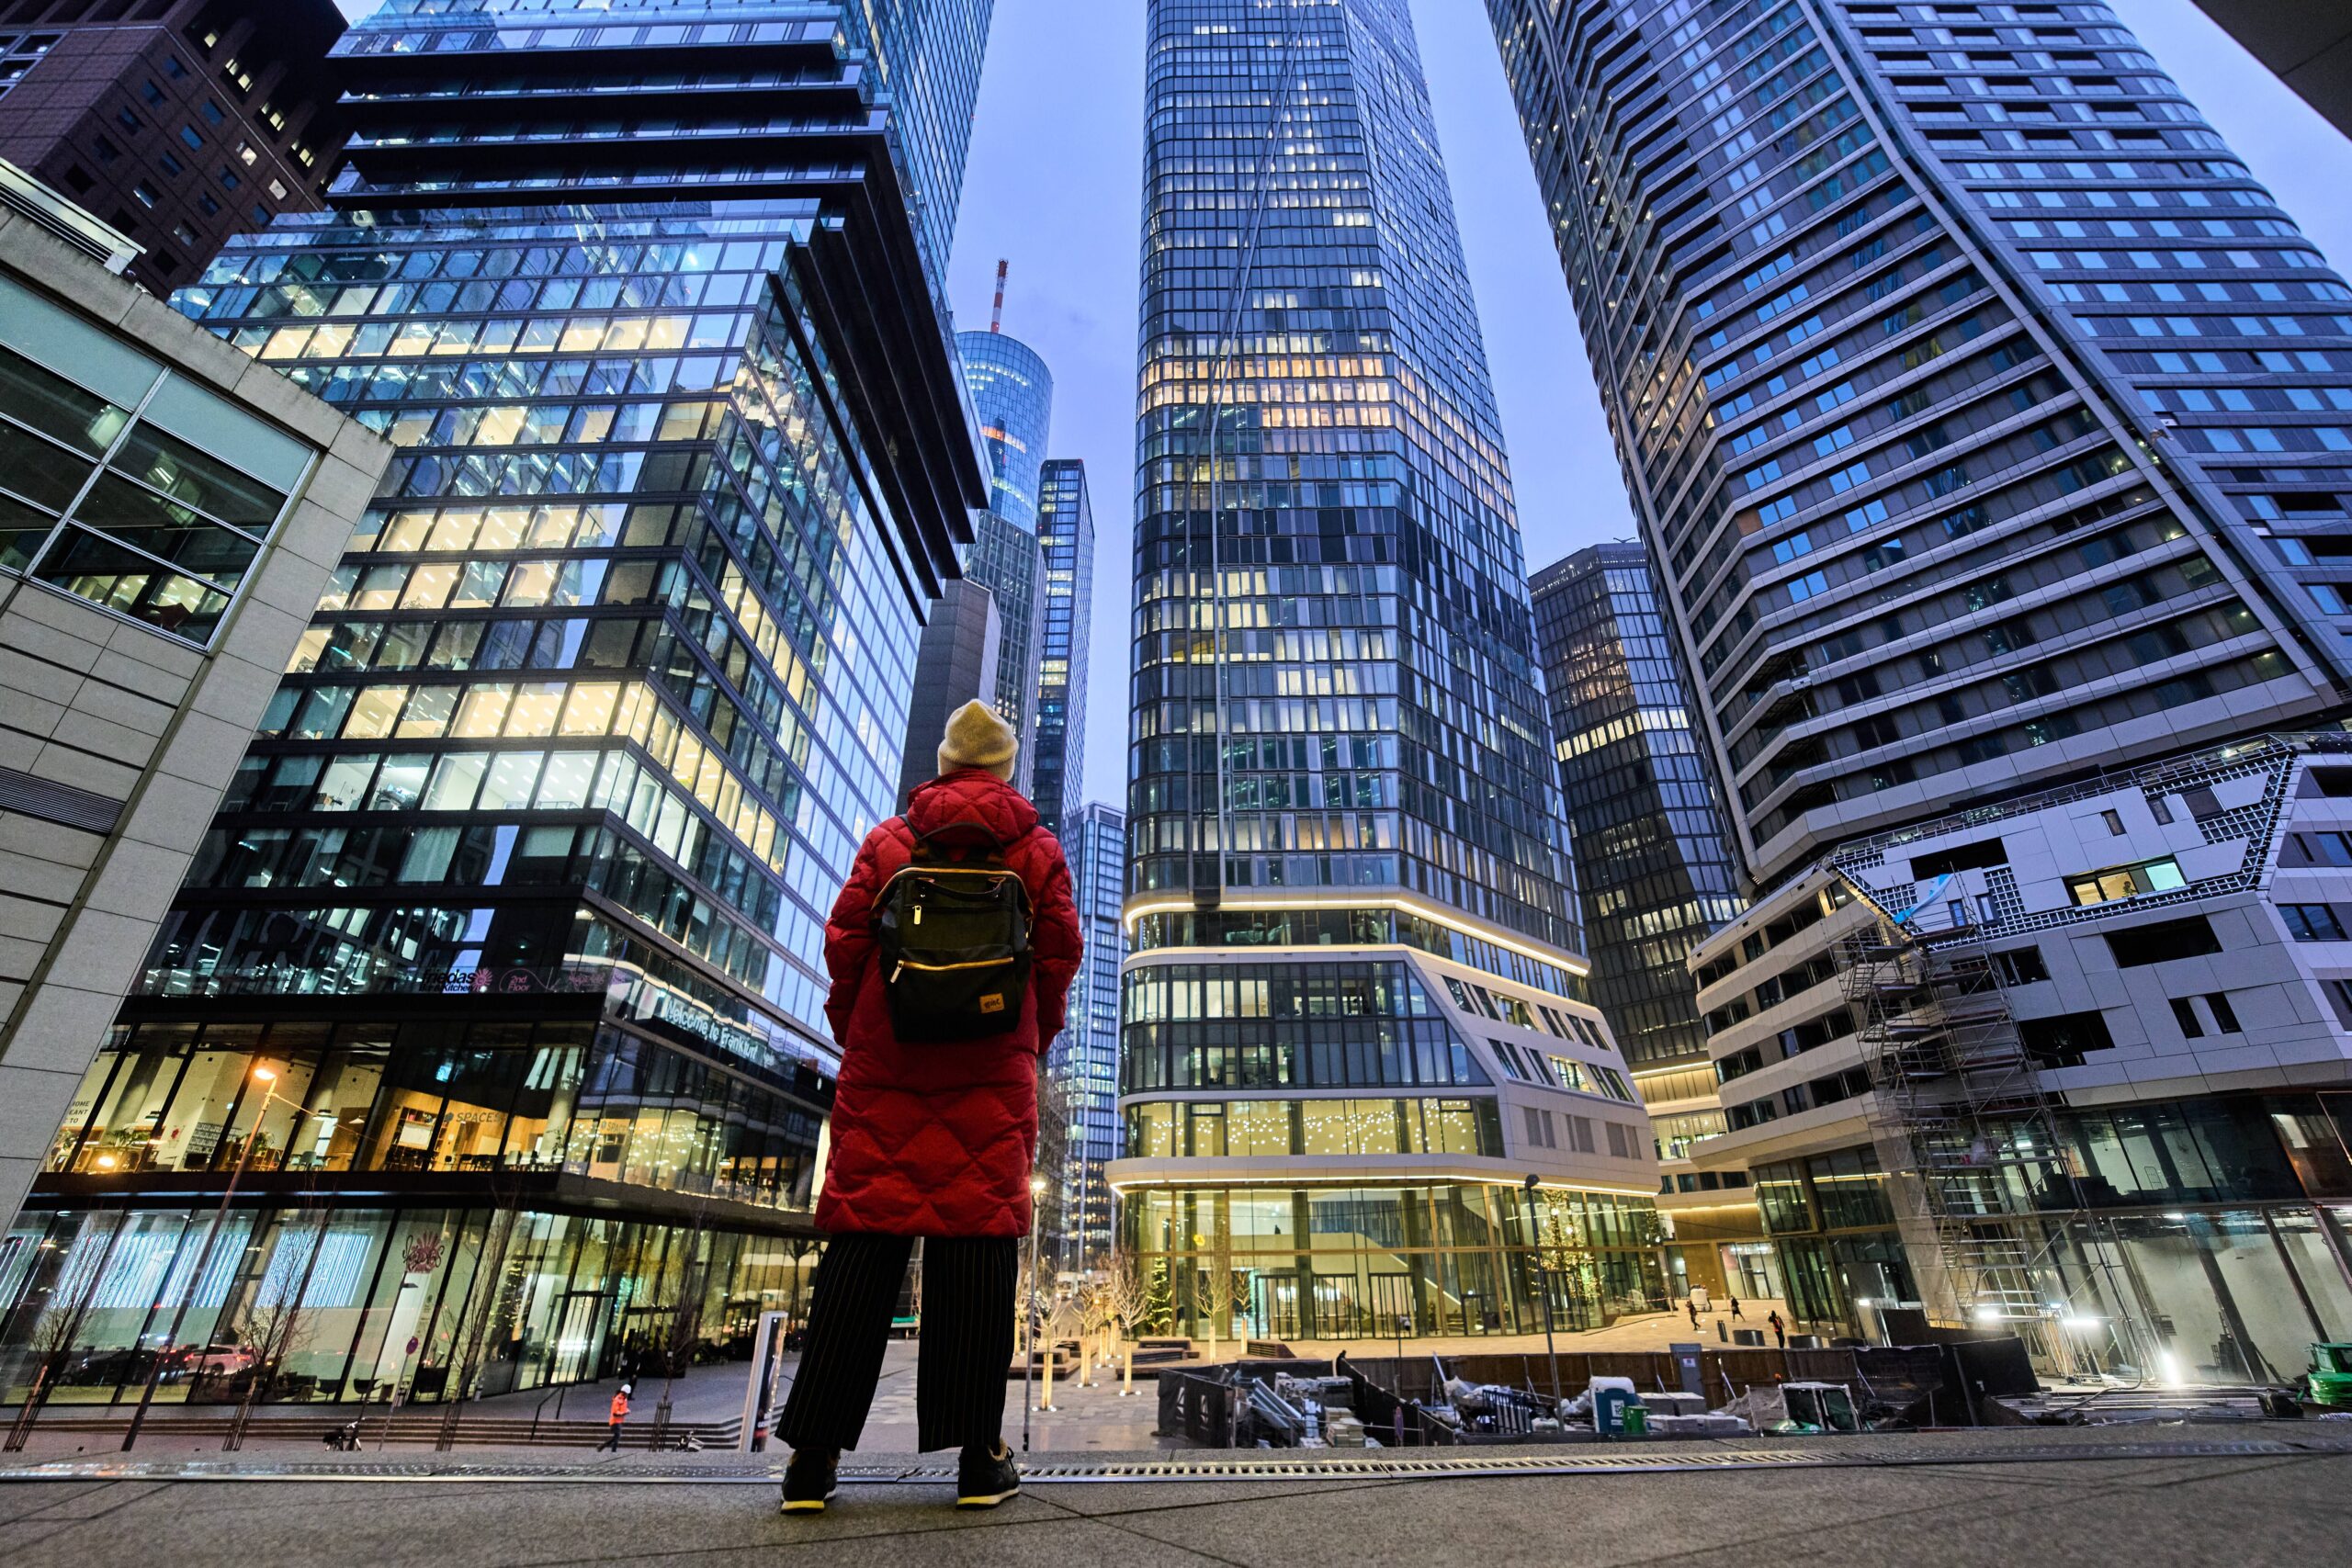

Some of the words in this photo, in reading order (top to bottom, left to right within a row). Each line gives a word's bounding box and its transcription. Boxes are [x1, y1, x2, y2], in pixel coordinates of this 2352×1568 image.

[422, 968, 475, 984] friedas
[510, 975, 527, 984] 2nd
[442, 983, 473, 992] Kitchen
[507, 983, 530, 992] Floor
[666, 999, 708, 1034] Welcome
[709, 1021, 719, 1041] to
[720, 1027, 758, 1060] Frankfurt
